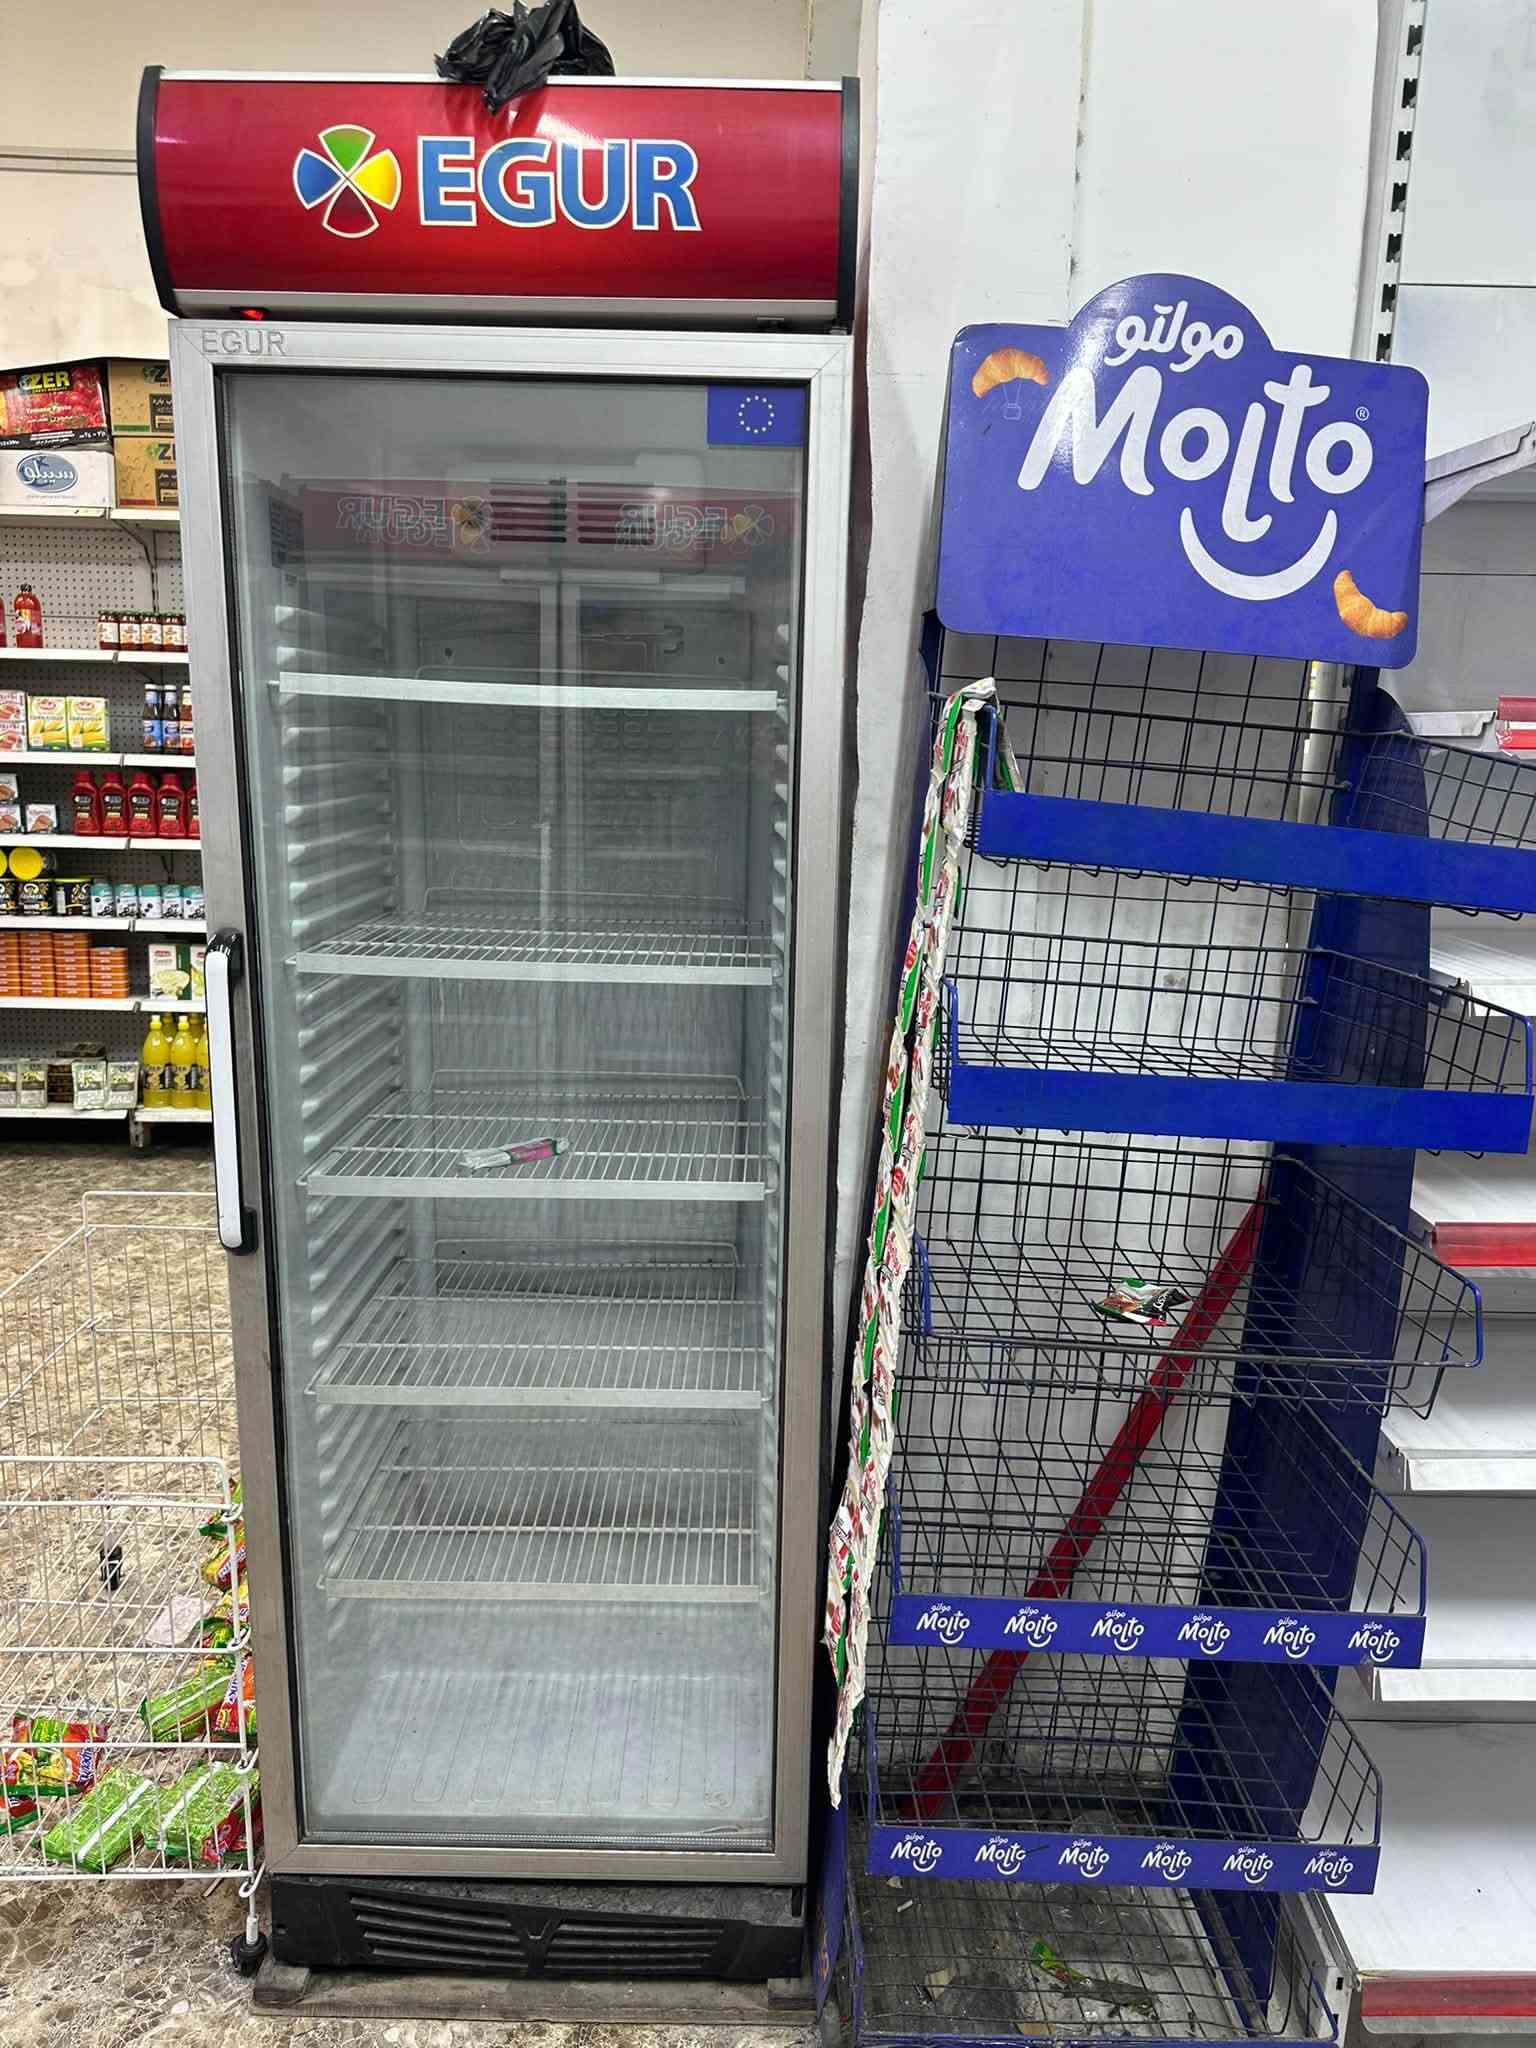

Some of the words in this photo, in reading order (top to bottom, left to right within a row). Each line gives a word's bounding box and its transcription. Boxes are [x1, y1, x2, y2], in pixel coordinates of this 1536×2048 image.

[417, 135, 702, 231] EGUR
[201, 328, 287, 357] EGUR
[1104, 300, 1244, 373] مولتو
[1017, 364, 1374, 543] Molto
[915, 1610, 971, 1637] Molto
[1003, 1613, 1058, 1641] Molto
[1090, 1616, 1145, 1644] Molto
[1176, 1620, 1231, 1647] Molto
[1262, 1624, 1316, 1651] Molto
[1347, 1628, 1401, 1655] Molto
[889, 1839, 943, 1865] Molto
[1057, 1845, 1110, 1871] Molto
[1140, 1849, 1193, 1874] Molto
[1222, 1852, 1274, 1877] Molto
[1303, 1855, 1354, 1880] Molto
